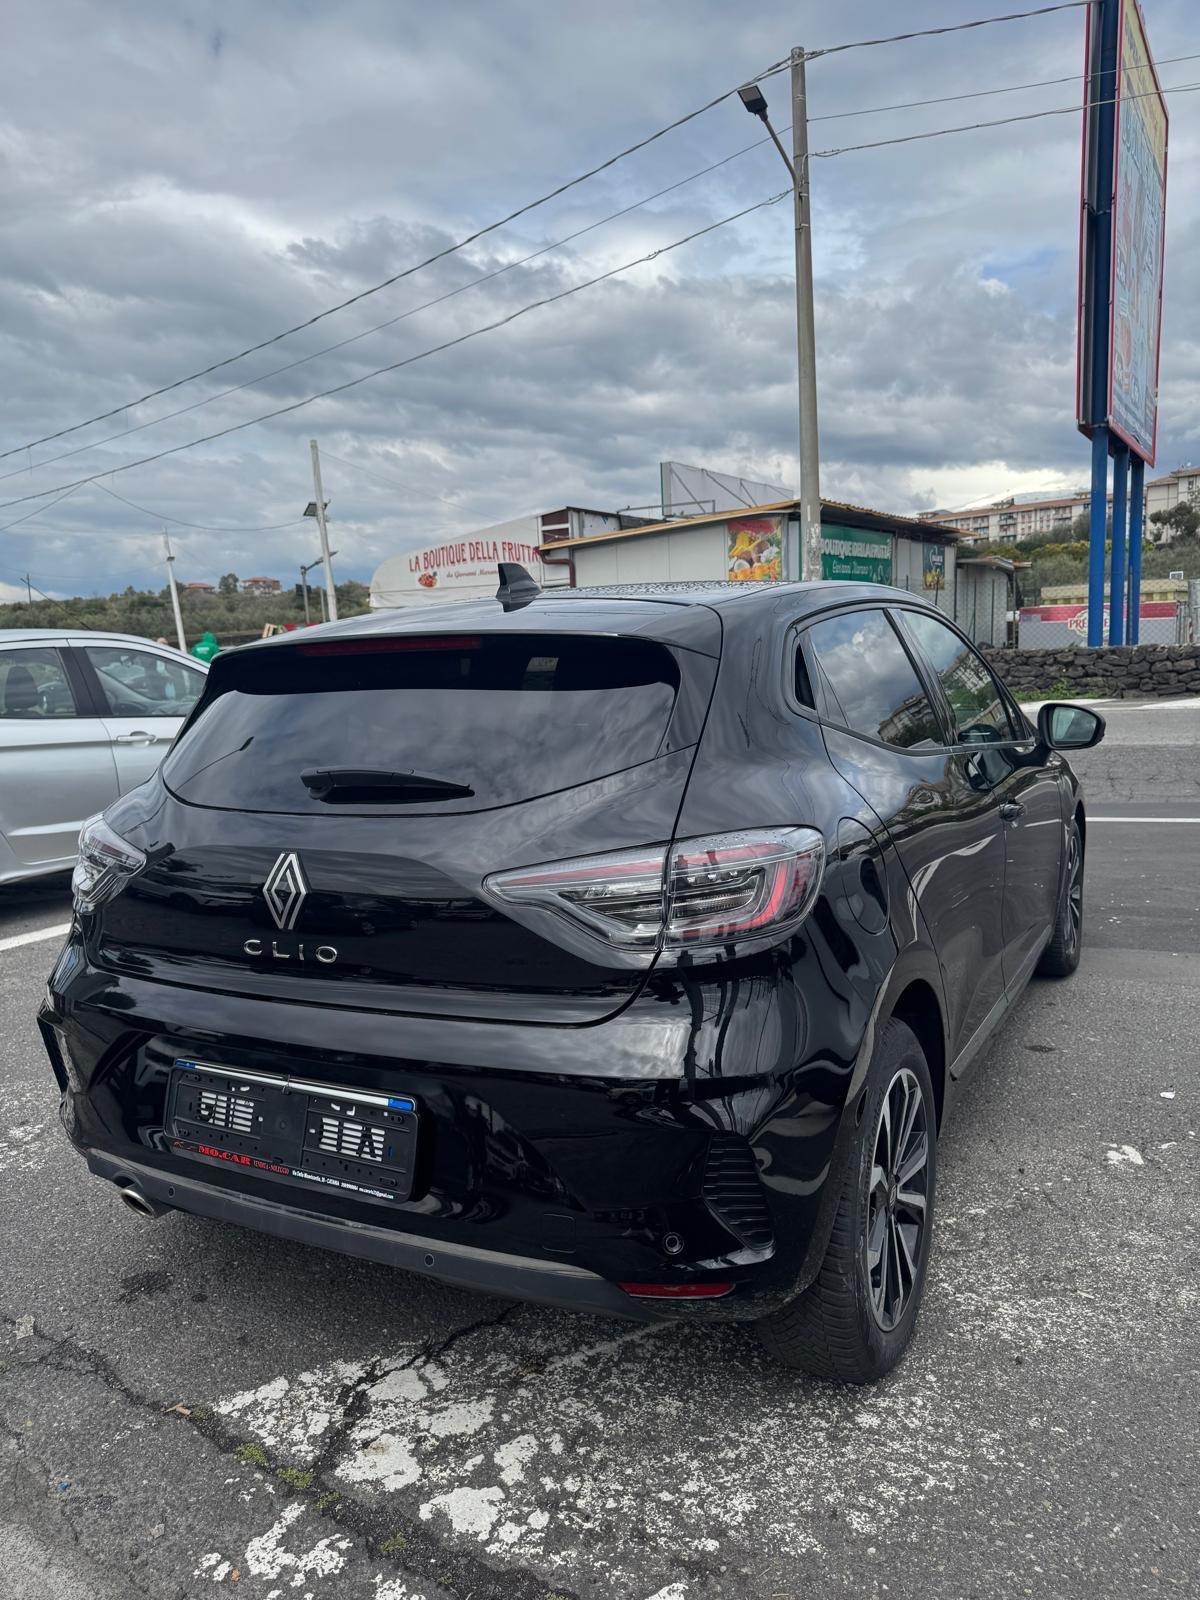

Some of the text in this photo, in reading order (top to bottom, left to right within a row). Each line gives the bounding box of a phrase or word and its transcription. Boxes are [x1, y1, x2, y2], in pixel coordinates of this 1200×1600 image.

[409, 541, 540, 572] LA BOUTIQUE DELLA FRUTTA
[243, 939, 338, 963] CLIO
